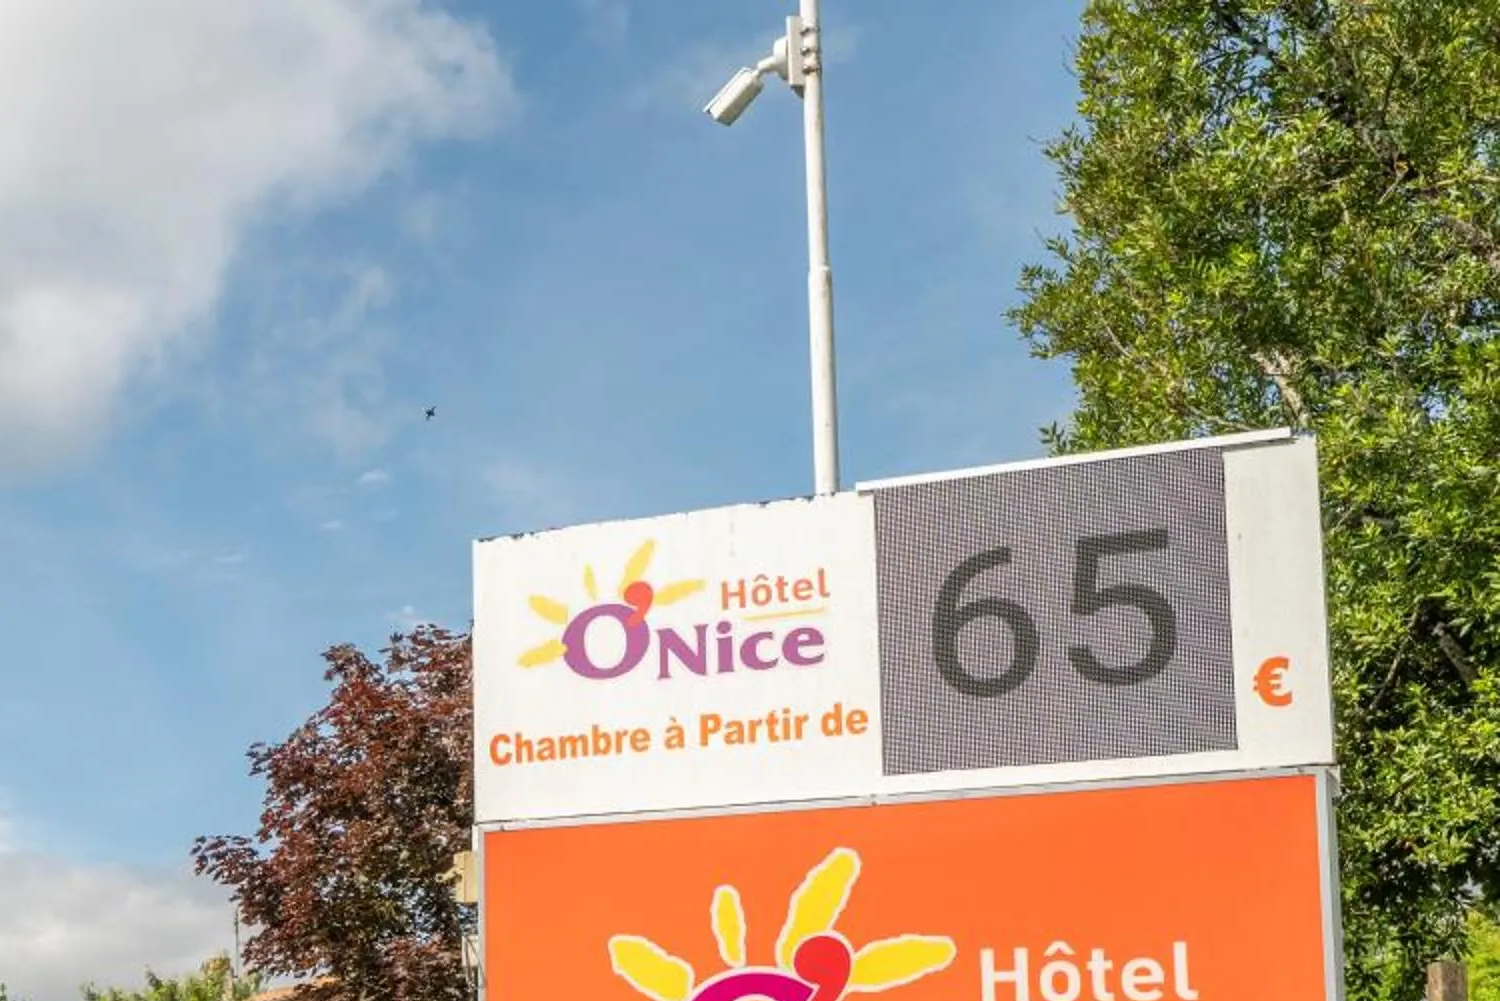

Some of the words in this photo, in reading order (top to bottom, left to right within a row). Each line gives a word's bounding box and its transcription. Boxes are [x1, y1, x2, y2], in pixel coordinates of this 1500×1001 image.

[720, 568, 831, 611] Hôtel
[931, 528, 1179, 698] 65
[1252, 656, 1293, 708] €
[489, 725, 651, 767] Chambre
[664, 717, 685, 750] à
[699, 707, 810, 747] Partir
[820, 702, 869, 738] de
